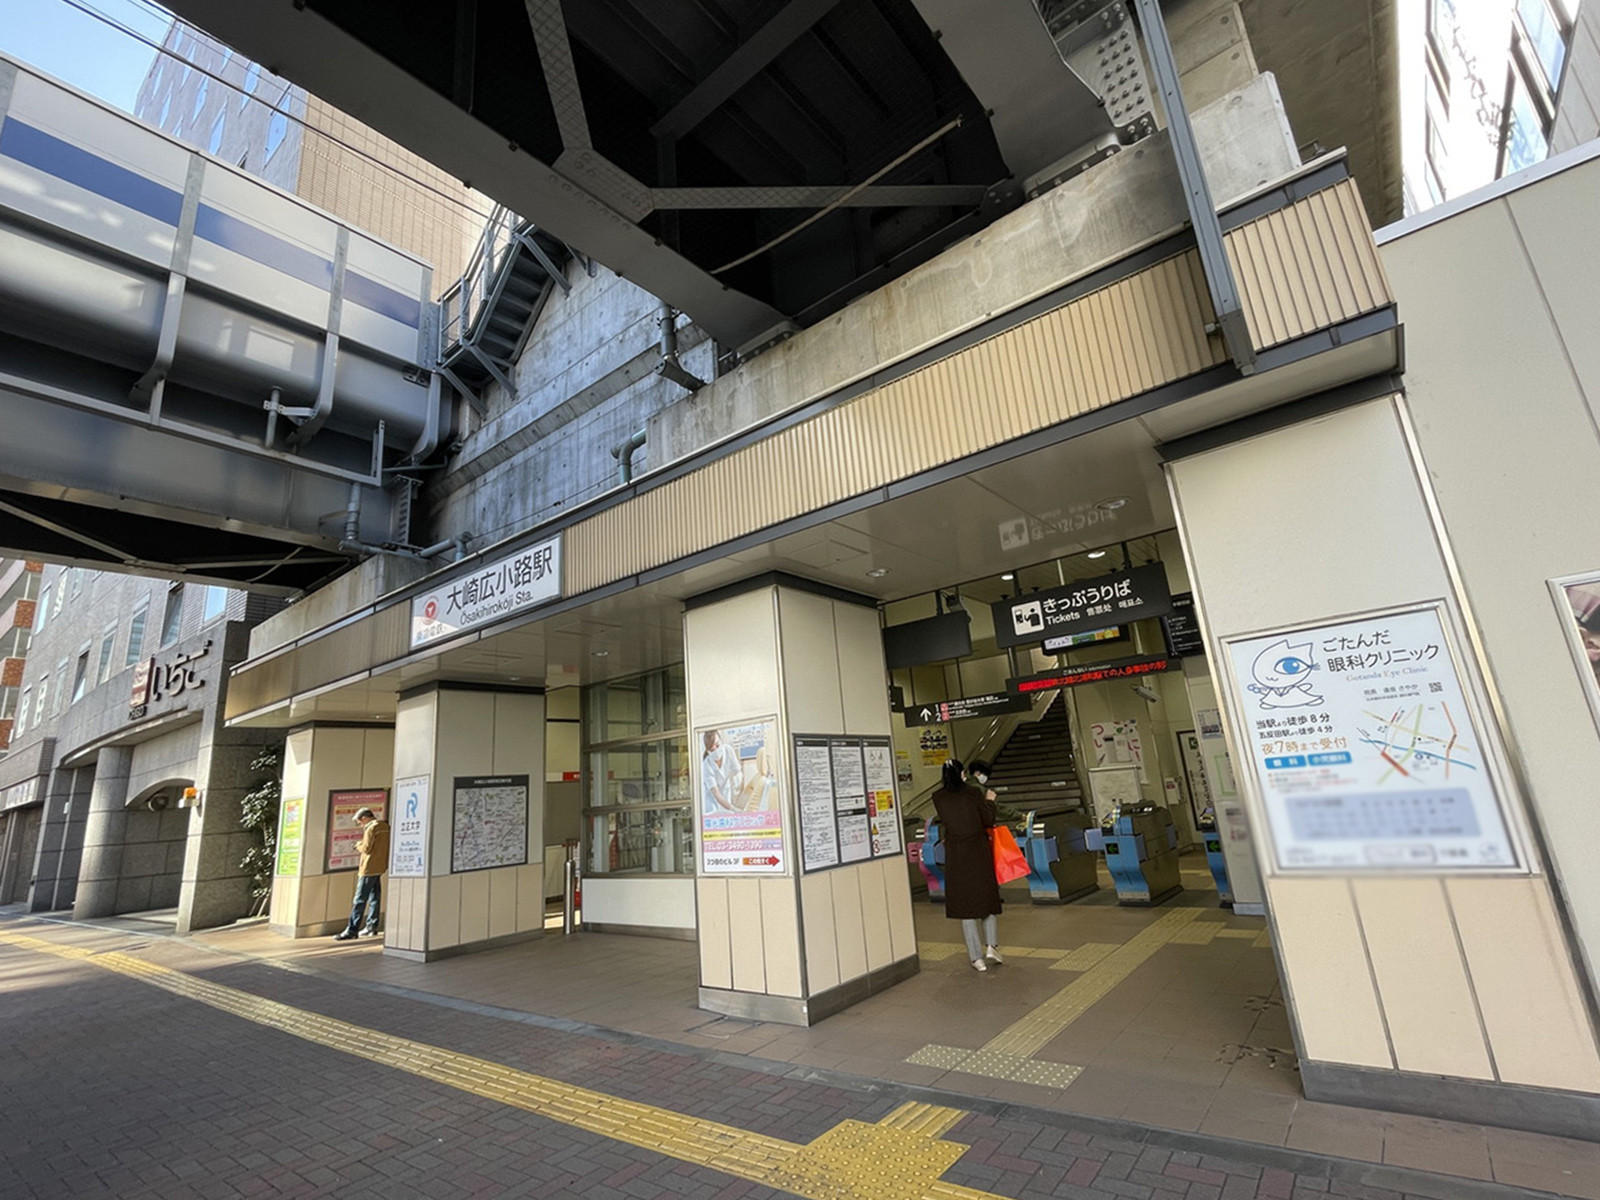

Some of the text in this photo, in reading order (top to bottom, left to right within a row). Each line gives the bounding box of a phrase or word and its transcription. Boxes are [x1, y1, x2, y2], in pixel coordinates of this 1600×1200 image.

[446, 545, 553, 615] 大崎広小路駅
[515, 590, 534, 606] Sta.
[1043, 578, 1132, 613] きっぷうりば
[1045, 610, 1081, 625] Tickets
[1322, 629, 1391, 653] ごたんだ
[1327, 644, 1439, 672] 眼科クリニック
[152, 639, 213, 702] いちご
[1346, 666, 1428, 681] Gotanda Eye Clinic
[935, 712, 942, 722] 2
[1256, 712, 1330, 730] 当駅より徒歩8分
[1261, 736, 1347, 755] 夜7時まで受付
